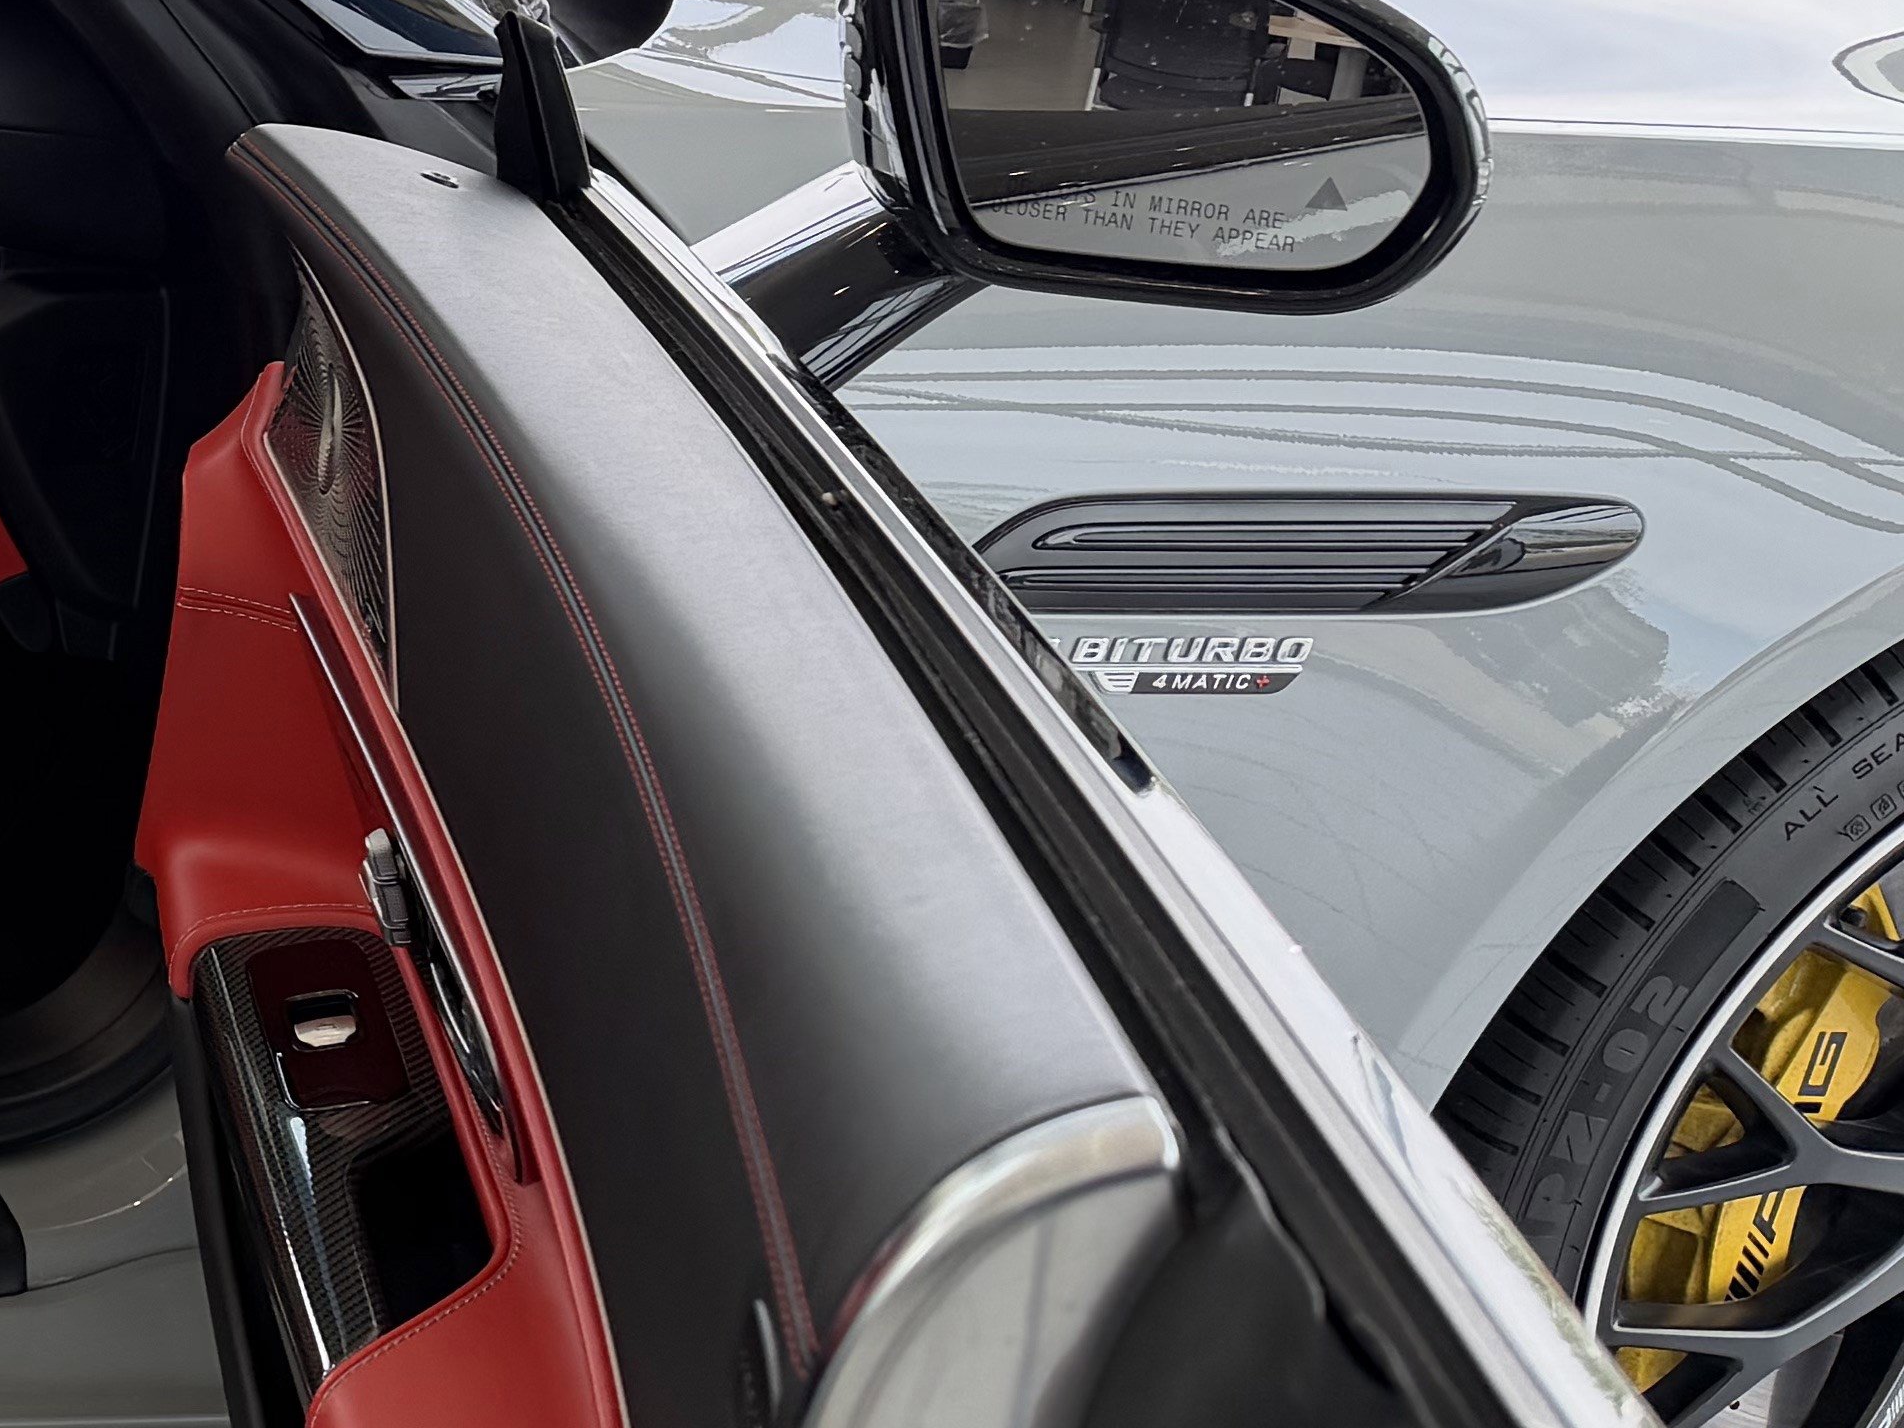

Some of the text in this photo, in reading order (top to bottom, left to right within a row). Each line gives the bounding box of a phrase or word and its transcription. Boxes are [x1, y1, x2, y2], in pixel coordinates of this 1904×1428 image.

[1084, 209, 1134, 231] THAN
[1148, 217, 1200, 239] THEY
[1212, 227, 1296, 252] APPEAR
[1112, 190, 1136, 209] IN
[1149, 195, 1230, 221] MIRROR
[1243, 208, 1285, 229] ARE
[1071, 637, 1314, 663] BITURBO
[1785, 794, 1839, 841] ALL
[1753, 1031, 1848, 1245] AG
